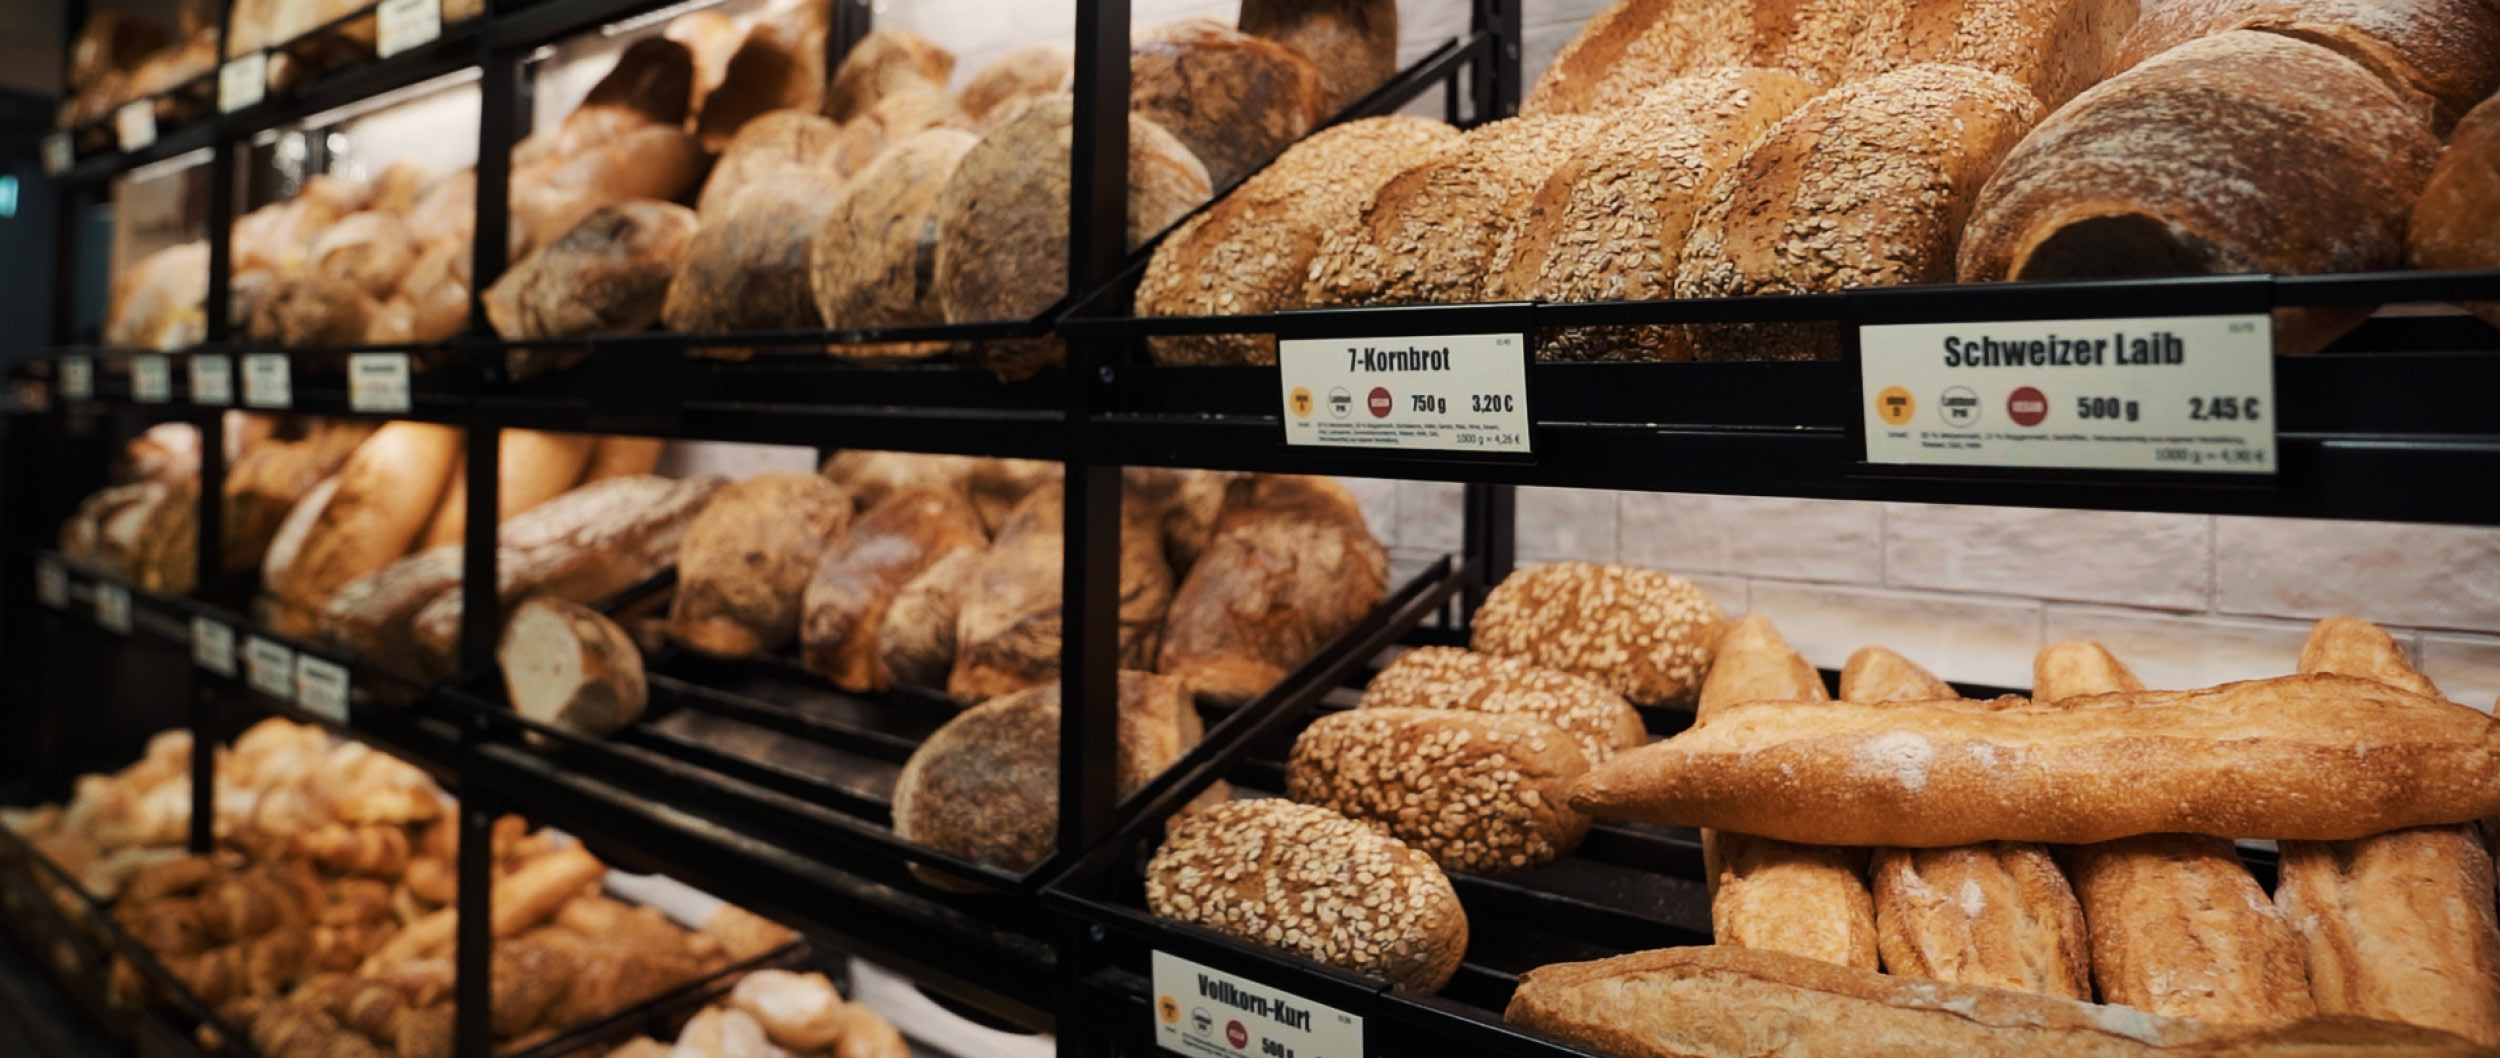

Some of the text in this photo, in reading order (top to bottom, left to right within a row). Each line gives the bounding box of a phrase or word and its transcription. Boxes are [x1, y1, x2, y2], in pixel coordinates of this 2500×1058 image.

[1347, 347, 1451, 372] 7-Kornbrot
[1944, 332, 2184, 367] Schweizer Laib
[1411, 394, 1447, 414] 750 g
[1472, 394, 1514, 413] 3,20 €
[2077, 397, 2139, 422] 500 g
[2189, 397, 2260, 421] 2,45 €
[1456, 433, 1476, 443] 1000
[1478, 436, 1484, 445] g
[1198, 973, 1312, 1033] Vollkorn-Kurt
[1262, 1037, 1284, 1058] 500
